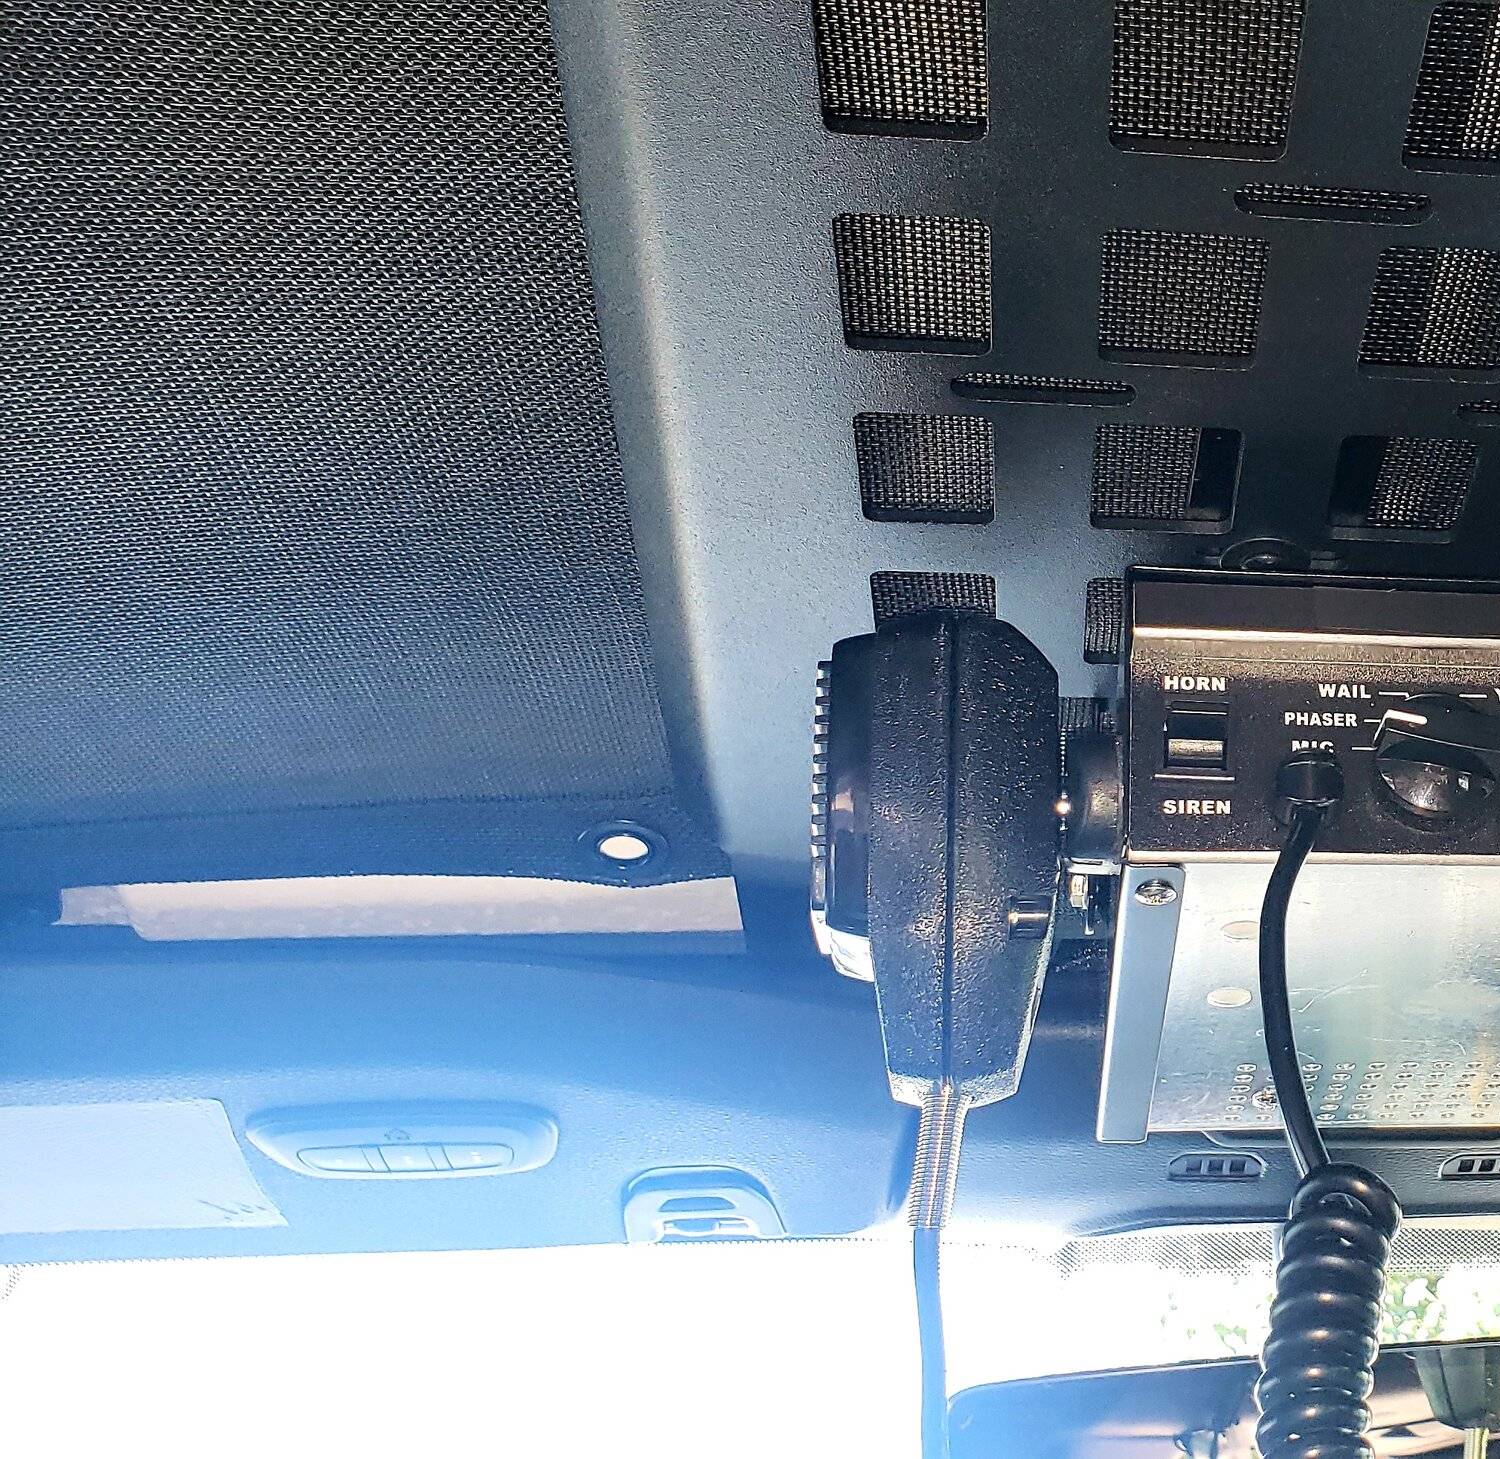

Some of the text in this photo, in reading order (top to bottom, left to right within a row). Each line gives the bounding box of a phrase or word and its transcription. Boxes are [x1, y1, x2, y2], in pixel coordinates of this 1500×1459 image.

[1164, 675, 1226, 692] HORN
[1318, 683, 1372, 699] WAIL
[1284, 711, 1358, 727] PHASER
[1162, 799, 1231, 815] SIREN
